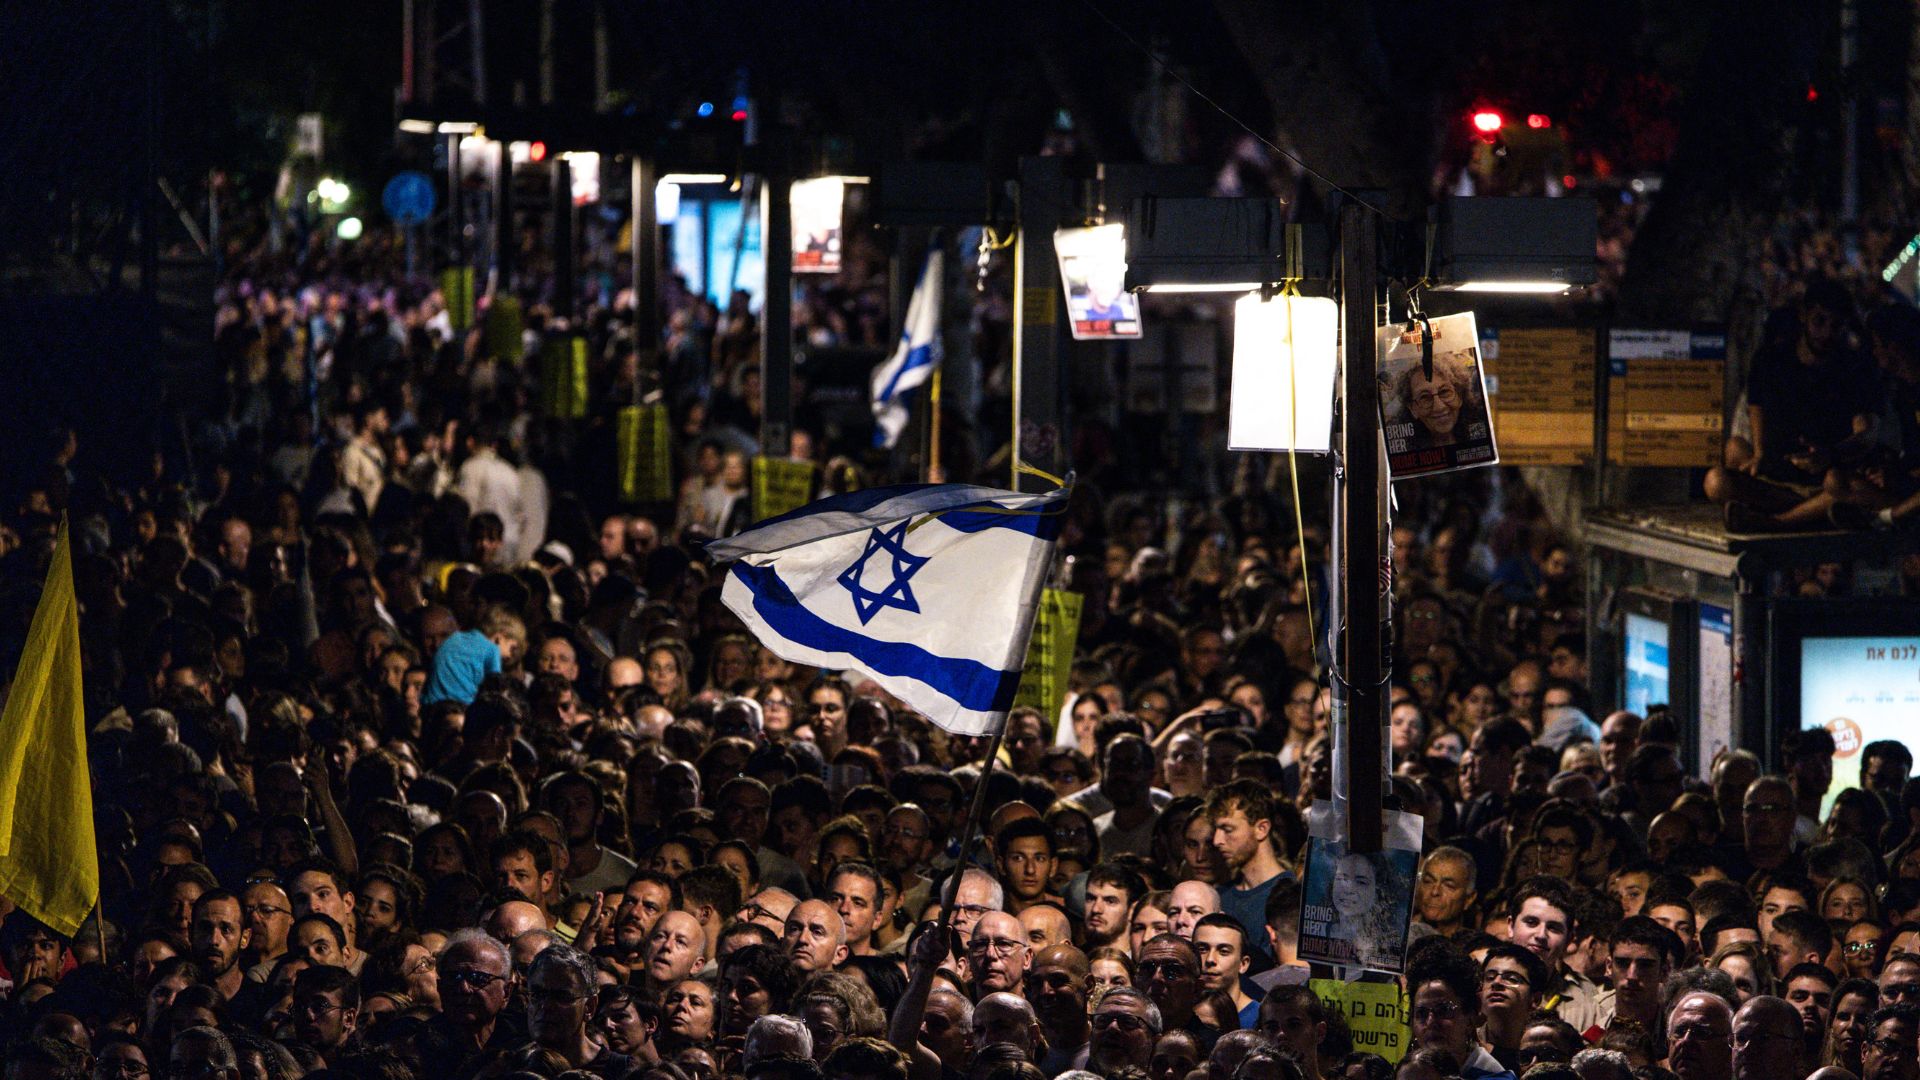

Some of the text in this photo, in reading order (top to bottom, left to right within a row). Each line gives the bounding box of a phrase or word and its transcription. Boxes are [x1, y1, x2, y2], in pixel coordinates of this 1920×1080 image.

[1386, 422, 1415, 440] BRING
[1388, 438, 1408, 455] HER
[1391, 451, 1418, 470] HOME
[1419, 447, 1446, 467] NOW!
[1867, 647, 1885, 660] את
[1303, 904, 1333, 923] BRING
[1303, 919, 1321, 935] HER
[1302, 936, 1328, 954] HOME
[1351, 1000, 1366, 1018] בן
